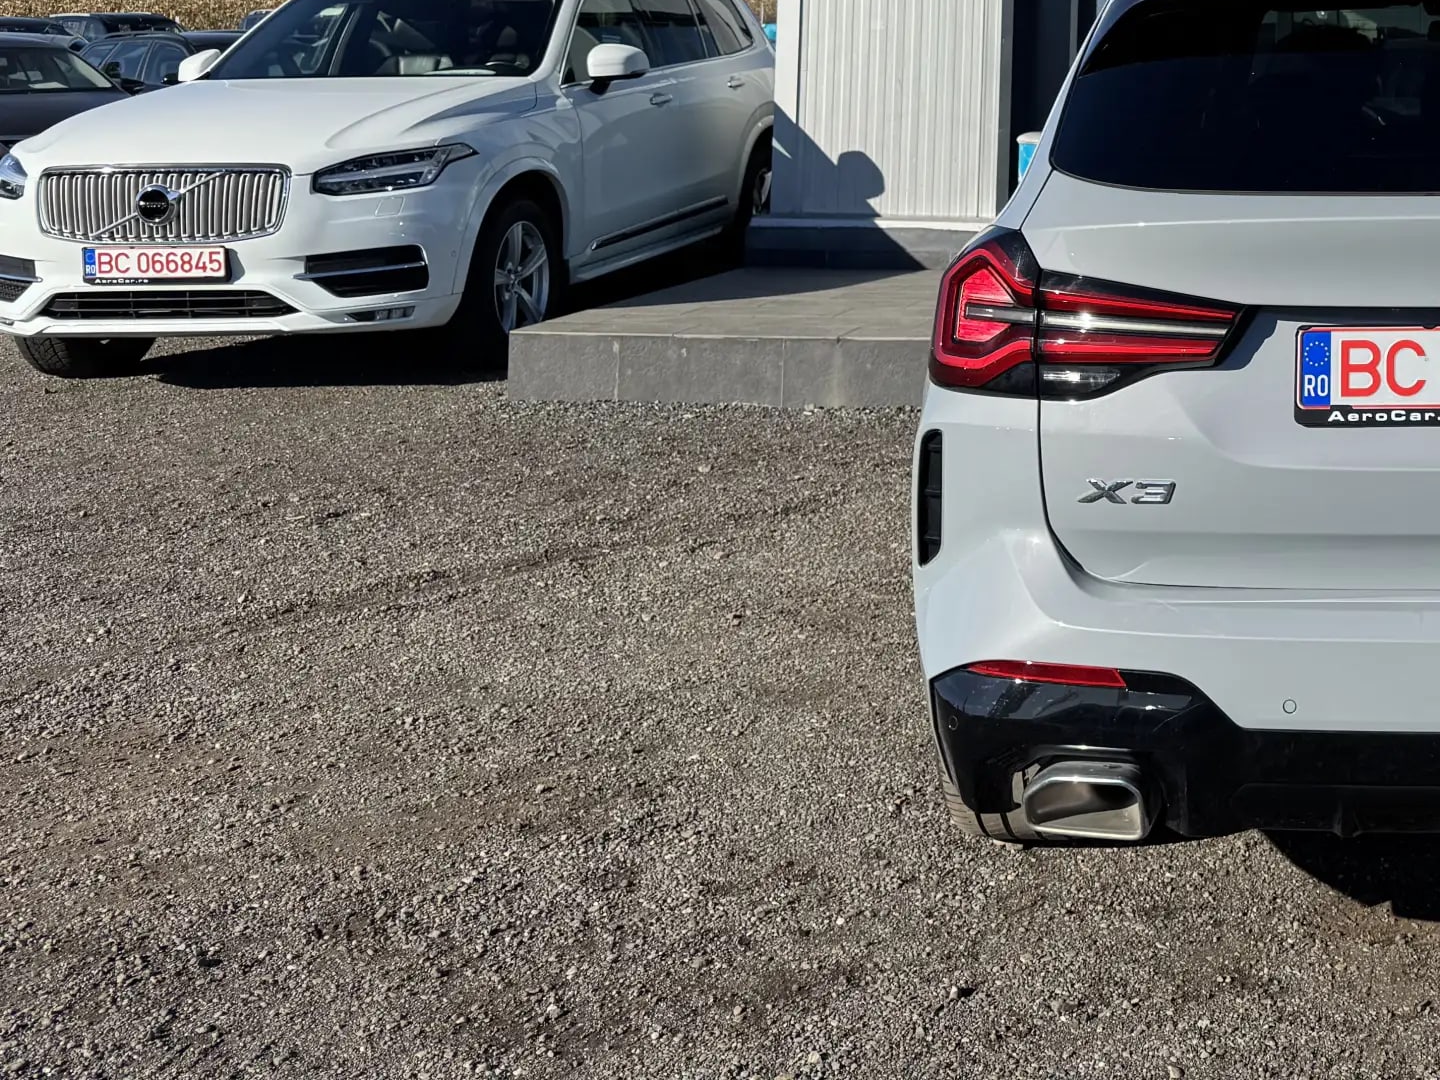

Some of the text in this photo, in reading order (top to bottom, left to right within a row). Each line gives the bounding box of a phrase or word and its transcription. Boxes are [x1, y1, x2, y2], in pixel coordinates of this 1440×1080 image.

[97, 250, 222, 274] BC 066845
[1340, 339, 1427, 398] BC
[1304, 374, 1329, 397] RO
[1077, 479, 1177, 505] X3
